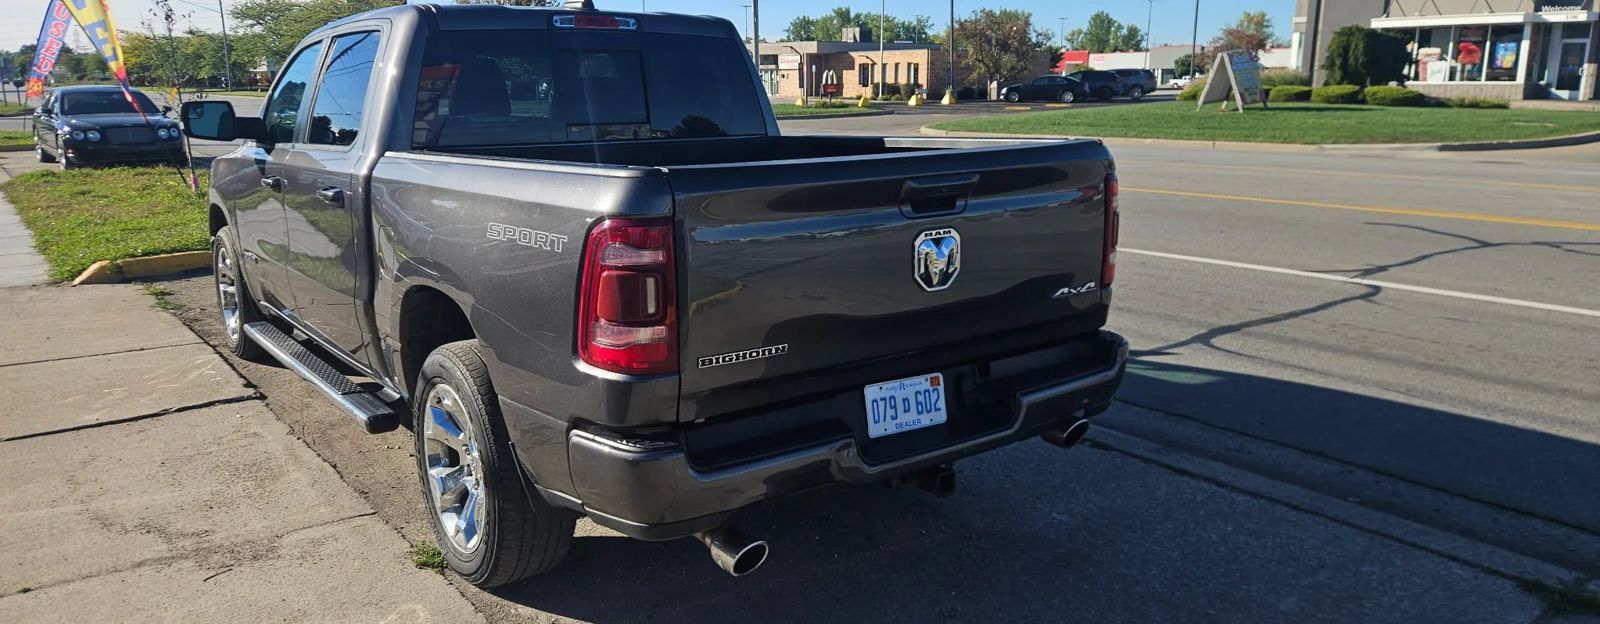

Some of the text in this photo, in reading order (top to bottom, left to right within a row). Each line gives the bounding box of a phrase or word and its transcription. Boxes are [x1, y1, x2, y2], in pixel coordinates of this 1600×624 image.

[1541, 5, 1582, 13] Welcome
[33, 1, 71, 75] USED
[487, 222, 568, 252] SPORT
[924, 229, 952, 238] RAM
[698, 343, 788, 368] BIGHORN
[871, 388, 942, 424] 079 D 602
[895, 418, 922, 430] DEALER
